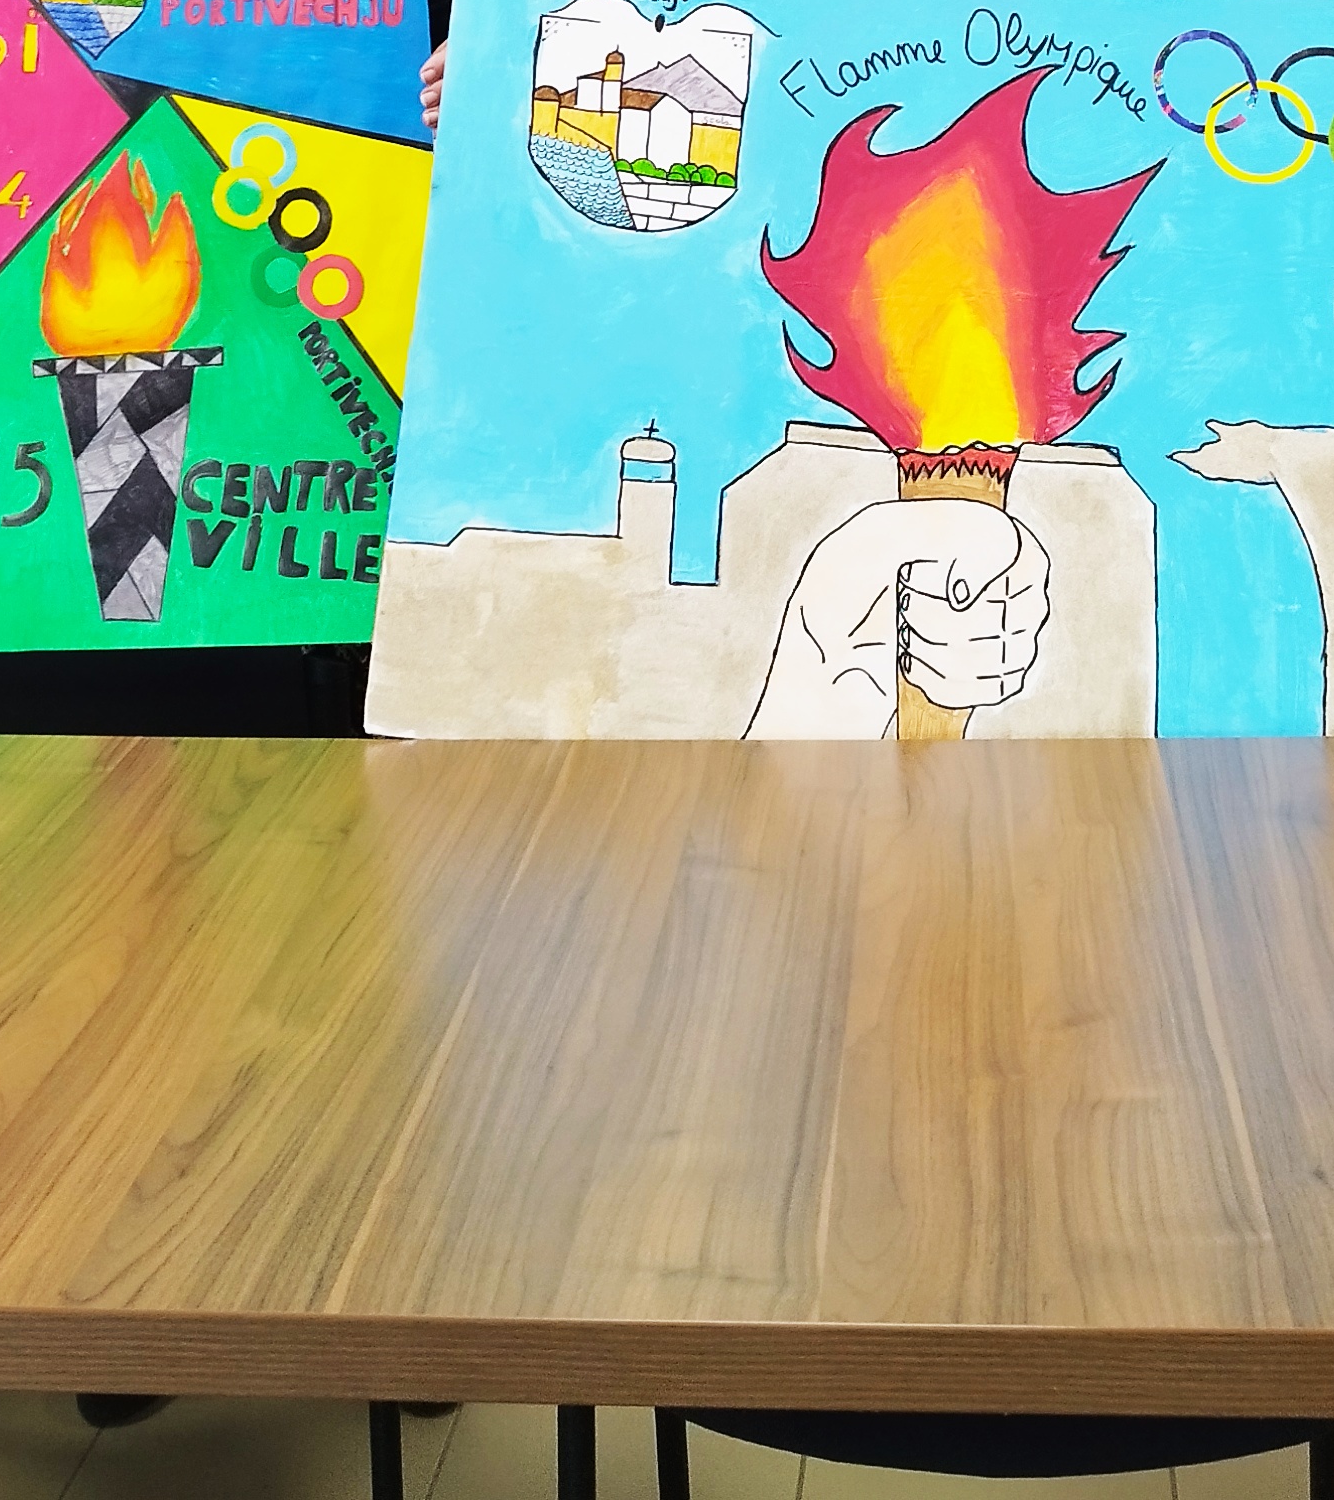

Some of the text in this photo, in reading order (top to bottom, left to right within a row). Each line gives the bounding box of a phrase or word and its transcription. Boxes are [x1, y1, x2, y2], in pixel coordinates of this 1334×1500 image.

[778, 8, 1146, 123] Flamme Olympique
[181, 458, 378, 519] CENTRE
